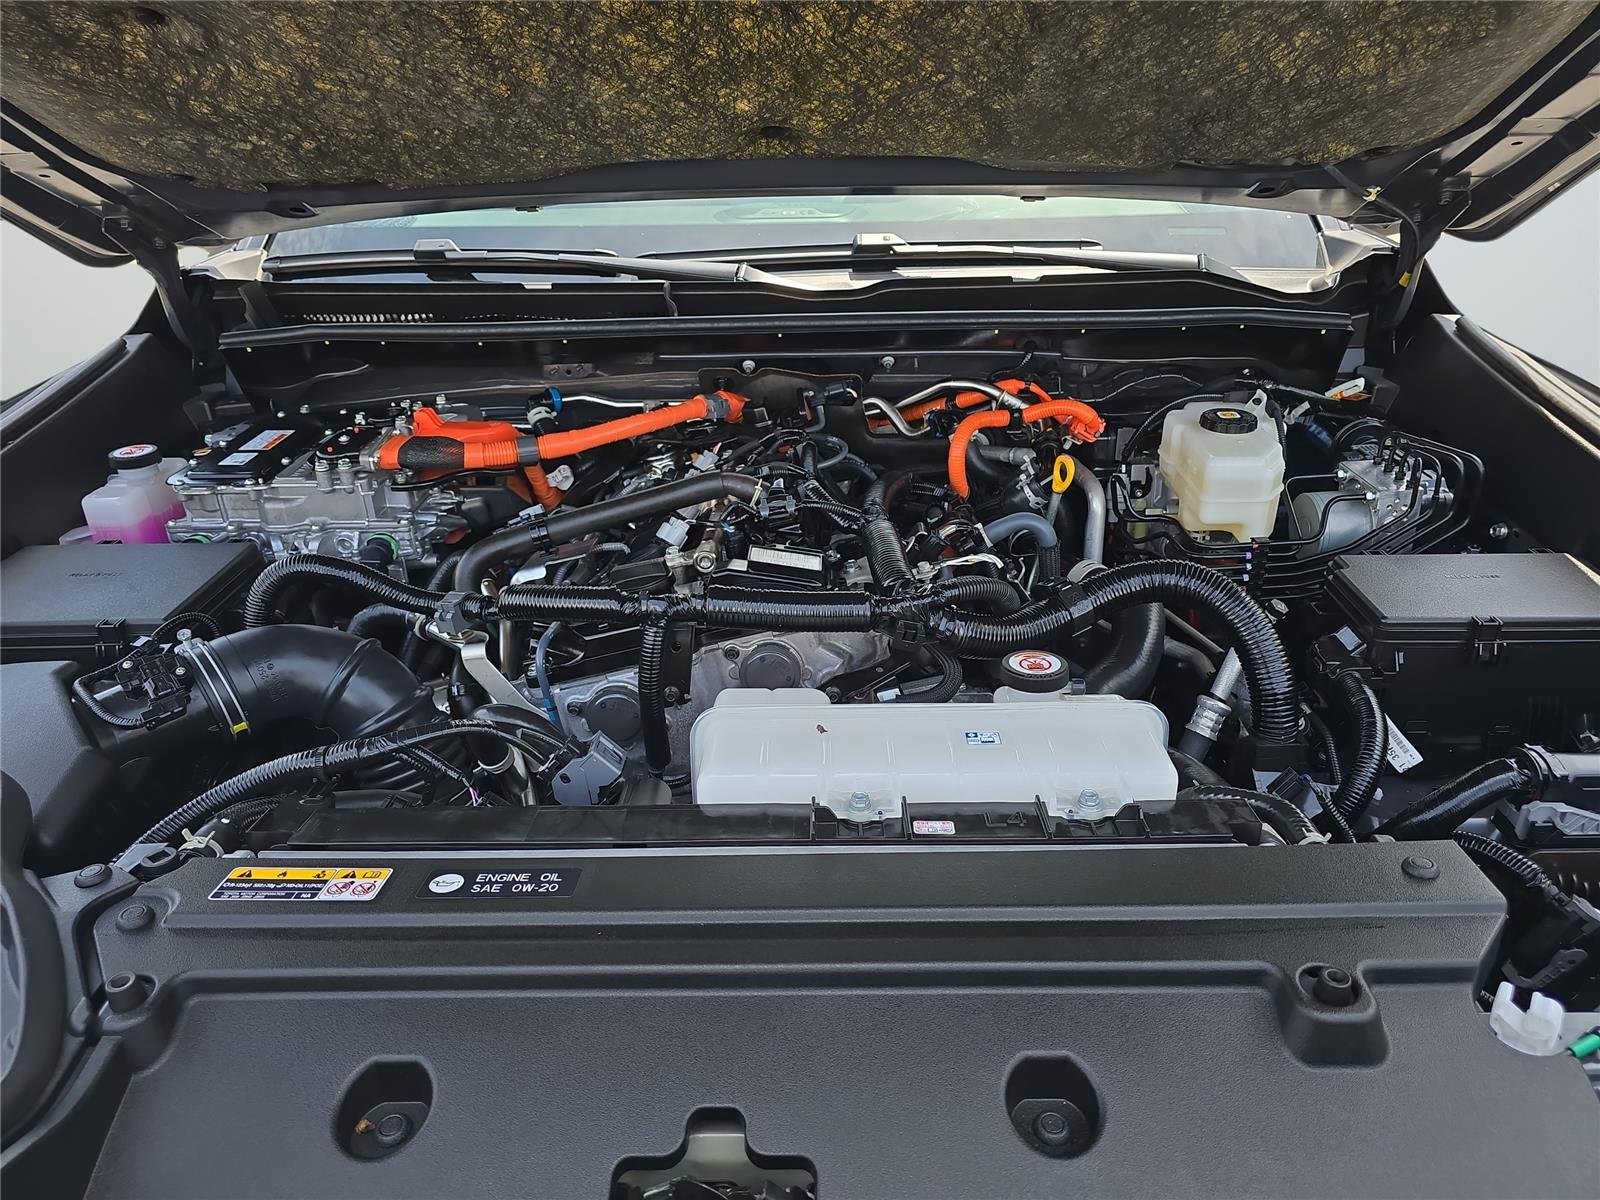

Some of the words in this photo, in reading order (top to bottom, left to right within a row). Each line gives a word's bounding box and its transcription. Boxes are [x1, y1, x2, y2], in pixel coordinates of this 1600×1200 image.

[475, 873, 532, 882] ENGINE
[540, 873, 563, 882] OIL
[470, 883, 503, 893] SAE
[511, 883, 559, 893] 0W-20
